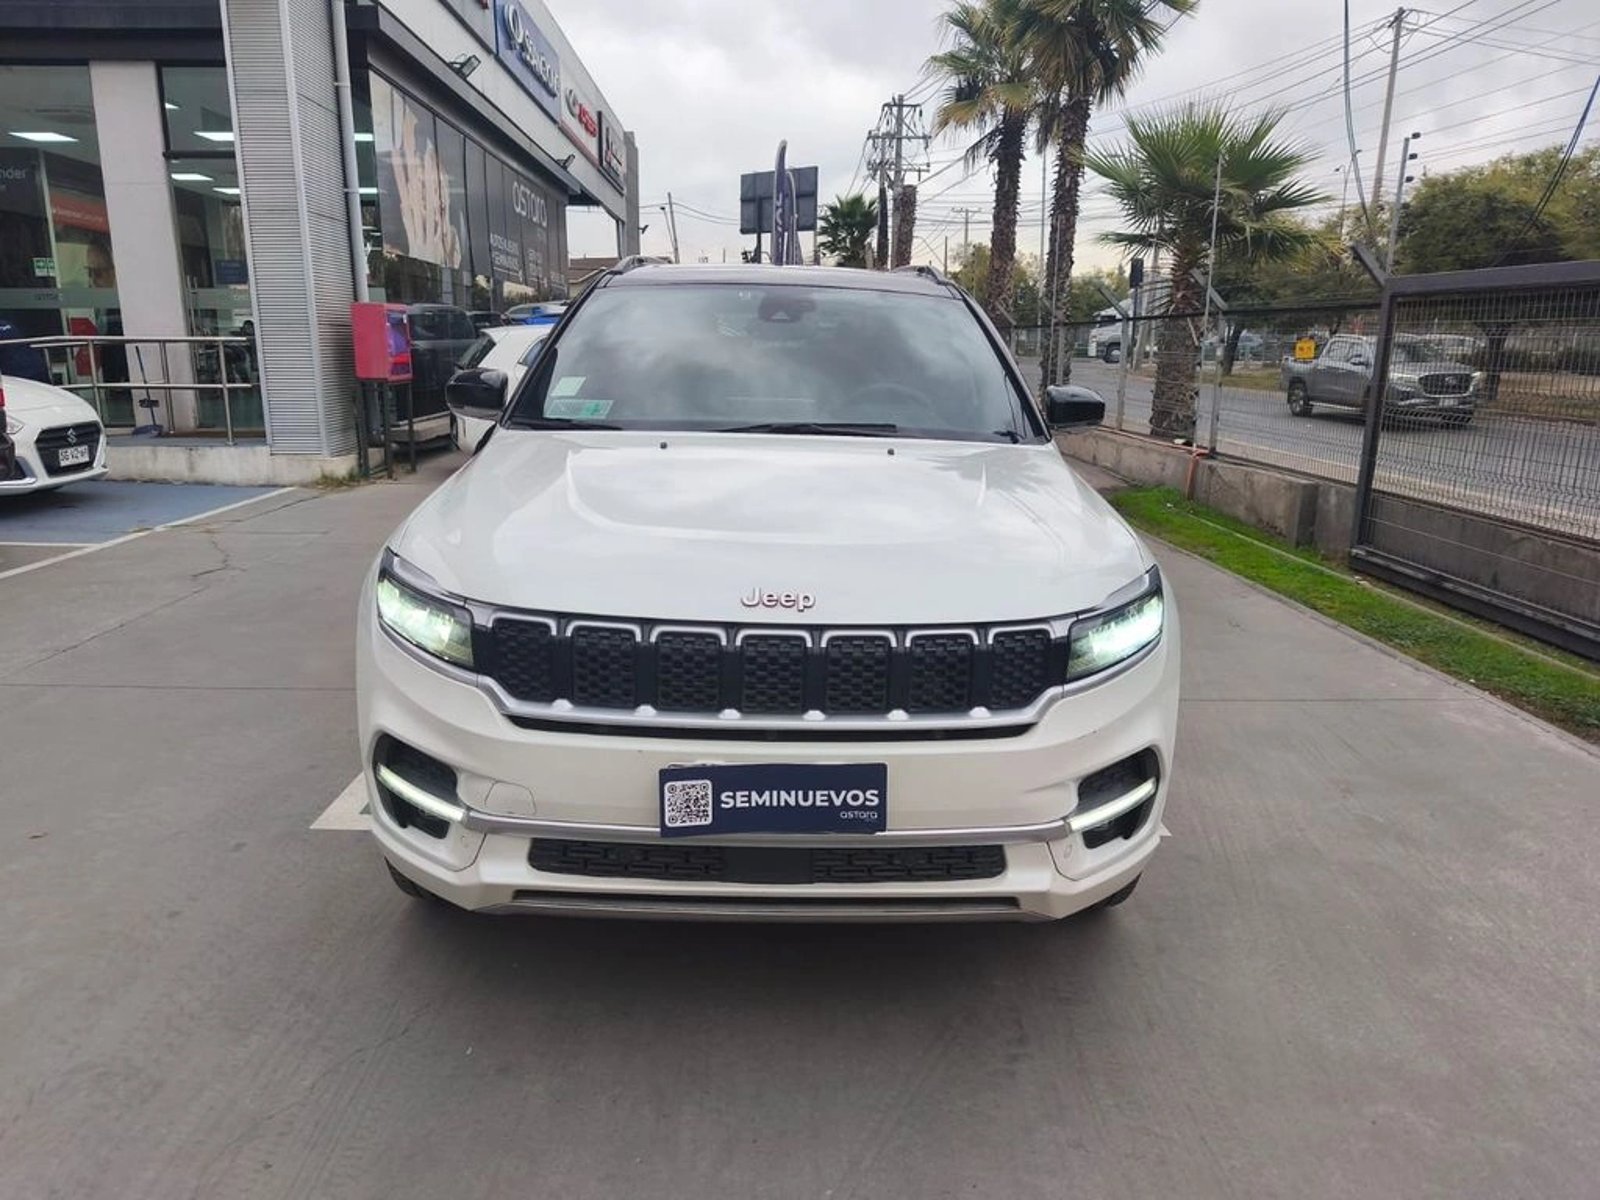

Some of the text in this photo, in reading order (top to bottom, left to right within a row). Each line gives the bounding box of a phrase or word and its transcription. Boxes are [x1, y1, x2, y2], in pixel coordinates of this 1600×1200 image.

[740, 586, 816, 612] Jeep
[720, 789, 880, 809] SEMINUEVOS
[839, 810, 878, 820] astara
